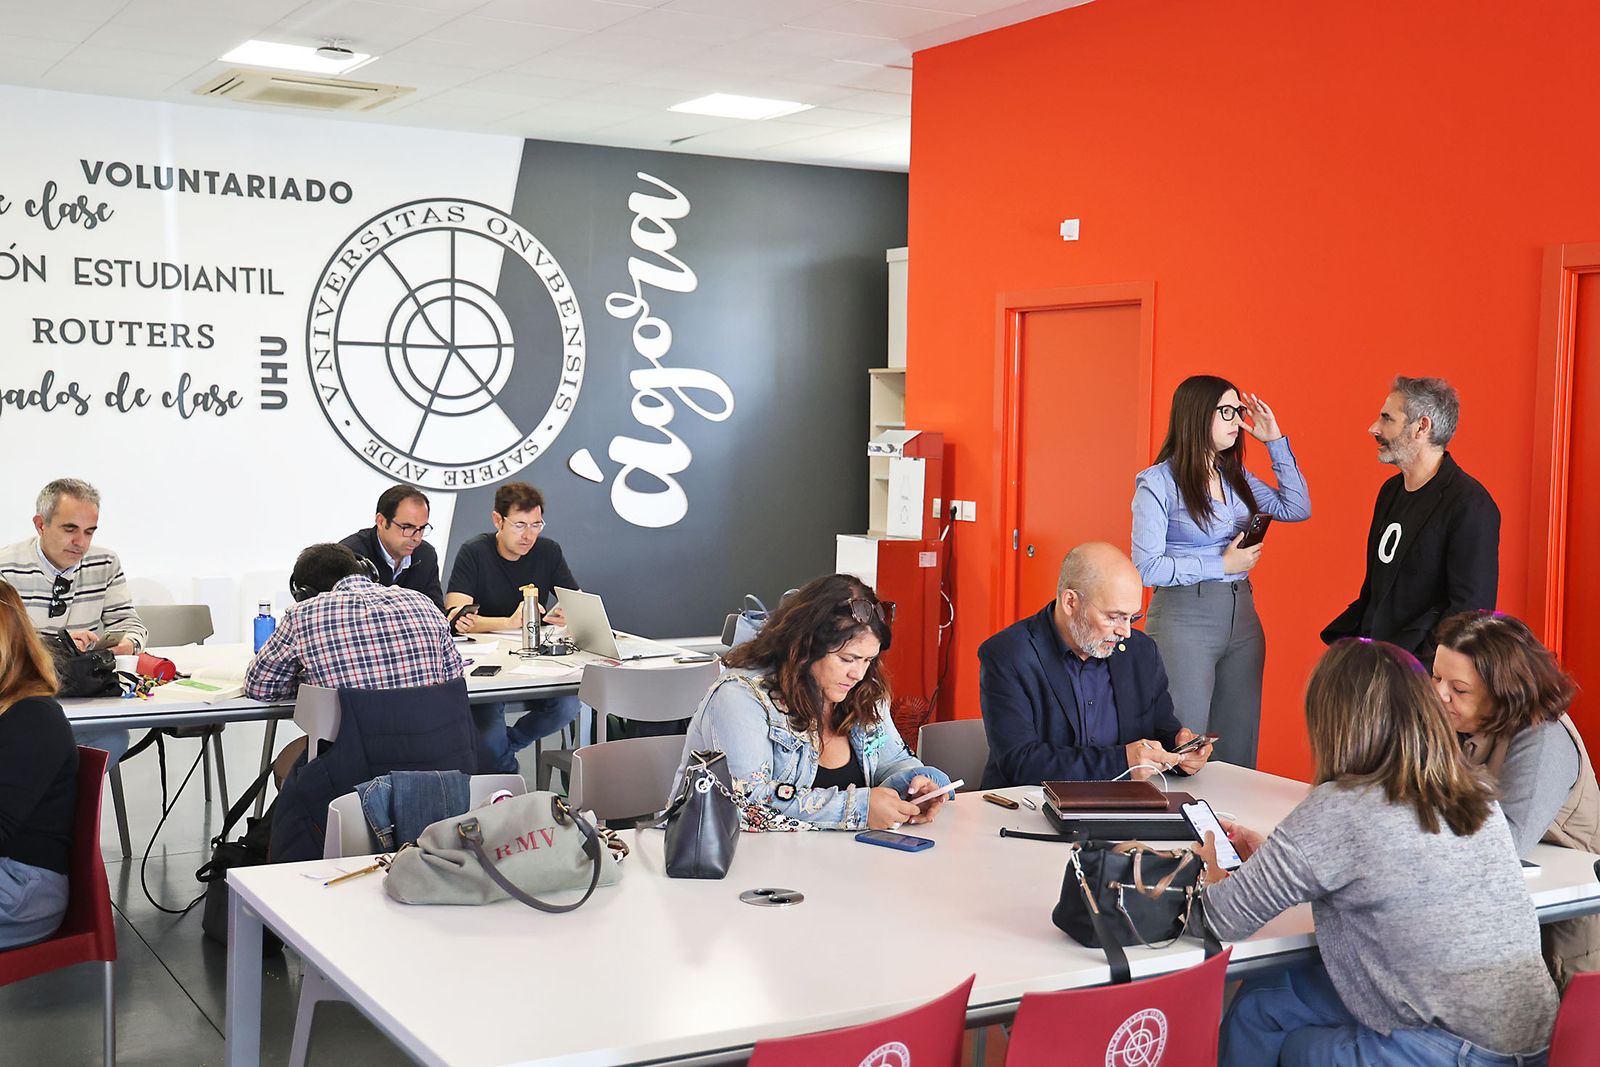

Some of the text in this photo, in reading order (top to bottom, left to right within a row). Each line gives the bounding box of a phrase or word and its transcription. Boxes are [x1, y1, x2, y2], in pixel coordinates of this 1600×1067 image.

[25, 180, 114, 231] clase
[80, 159, 353, 204] VOLUNTARIADO
[0, 242, 285, 296] ÓN ESTUDIANTIL
[32, 317, 215, 349] ROUTERS
[314, 206, 582, 413] VNIVERSITAS ONVBENSIS
[260, 335, 288, 410] UHU
[568, 171, 735, 528] ágora
[0, 369, 244, 420] ados de clase
[363, 438, 540, 486] SAPERE AVDE
[495, 826, 556, 861] RMV
